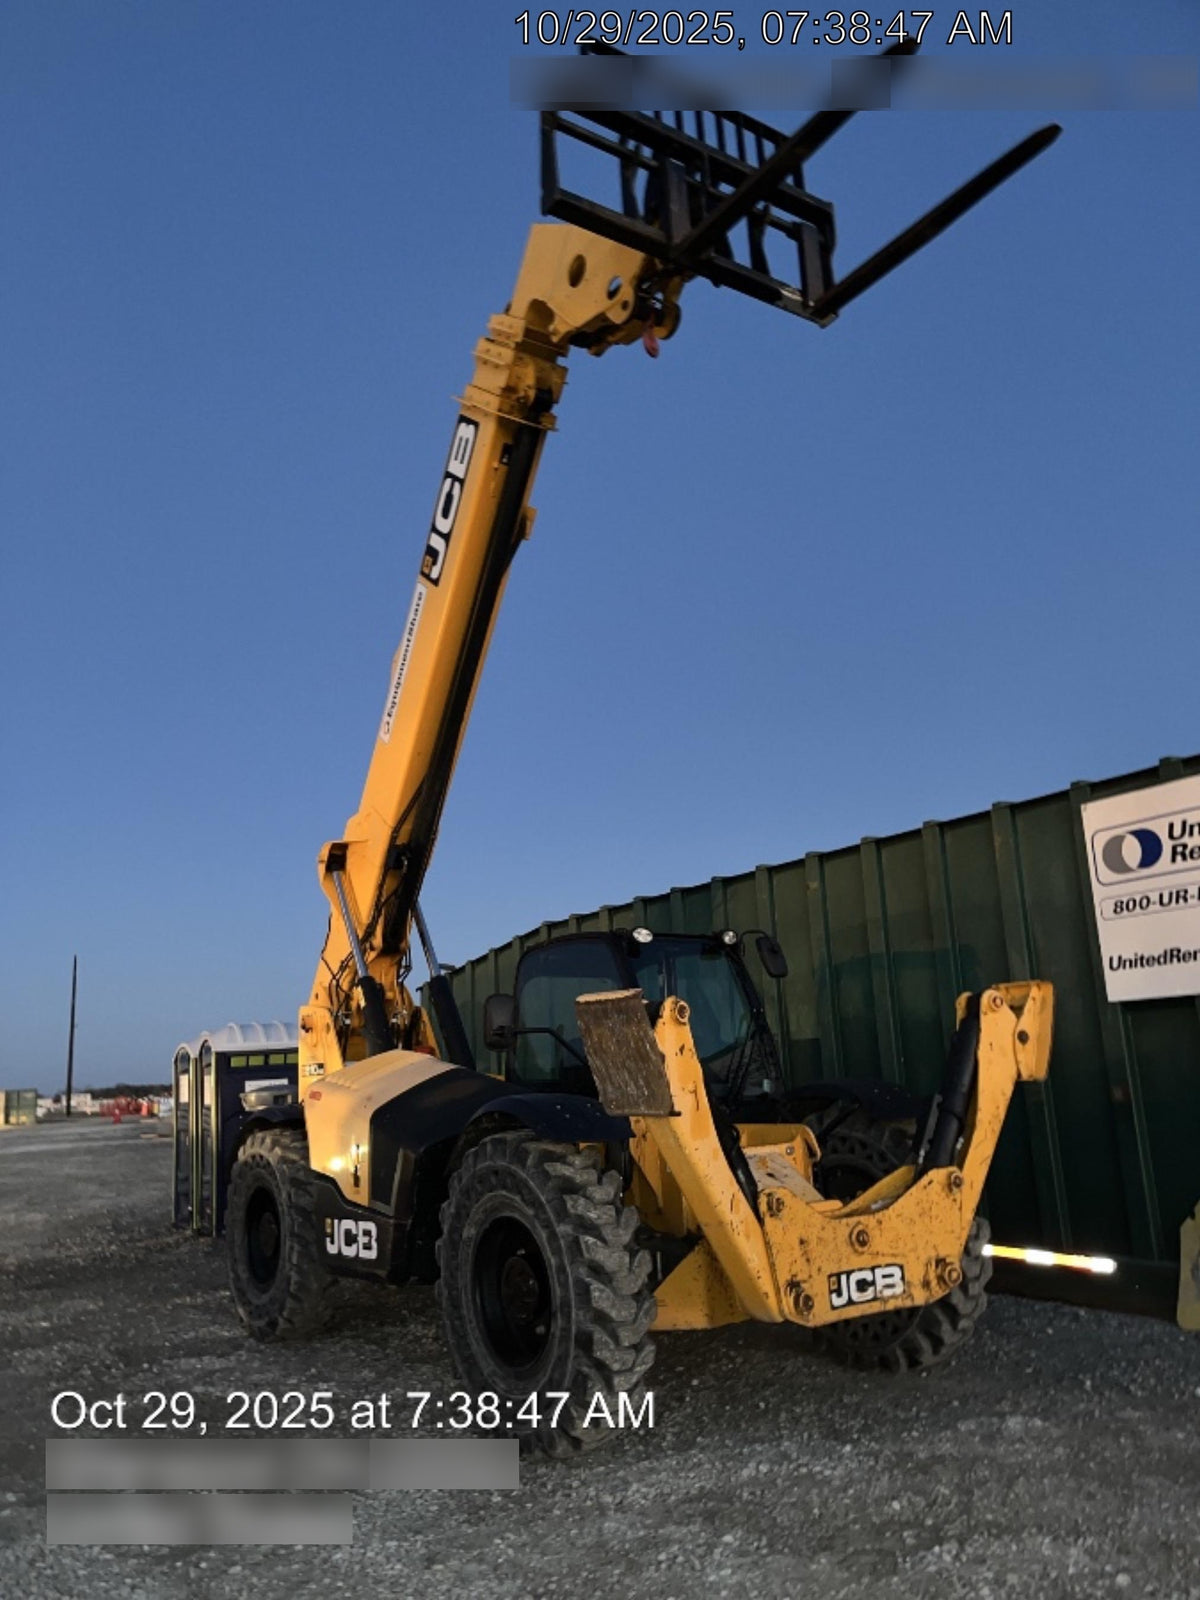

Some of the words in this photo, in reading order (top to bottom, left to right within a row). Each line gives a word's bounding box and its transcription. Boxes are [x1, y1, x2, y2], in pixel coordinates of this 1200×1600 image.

[426, 420, 476, 581] JCB
[1112, 886, 1200, 915] 800-UR-
[325, 1219, 377, 1260] JCB
[831, 1266, 904, 1307] JCB
